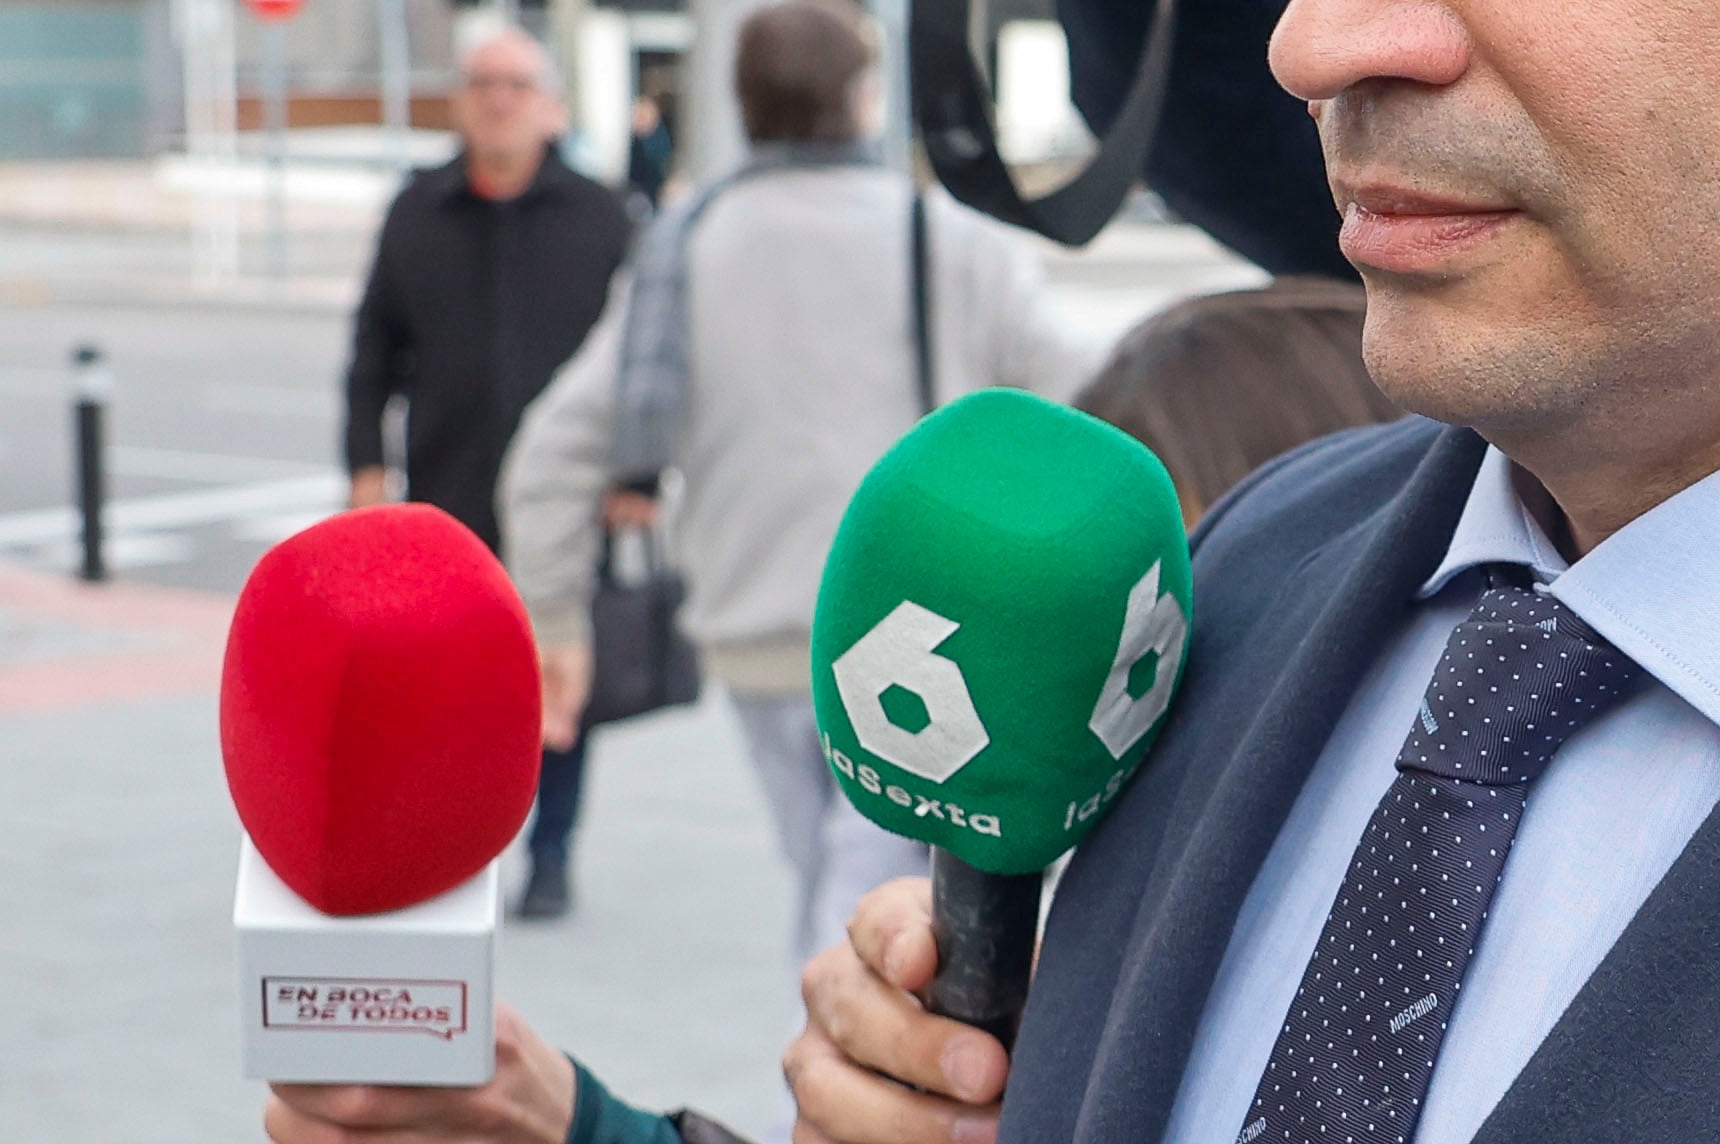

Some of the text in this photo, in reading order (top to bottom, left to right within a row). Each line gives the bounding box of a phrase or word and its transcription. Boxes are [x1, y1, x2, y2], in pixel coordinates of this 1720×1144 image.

[824, 731, 1002, 837] laSexta
[278, 986, 411, 1003] EN BOCA
[298, 1005, 449, 1021] DE TODOS
[1389, 992, 1438, 1035] MOSCHINO
